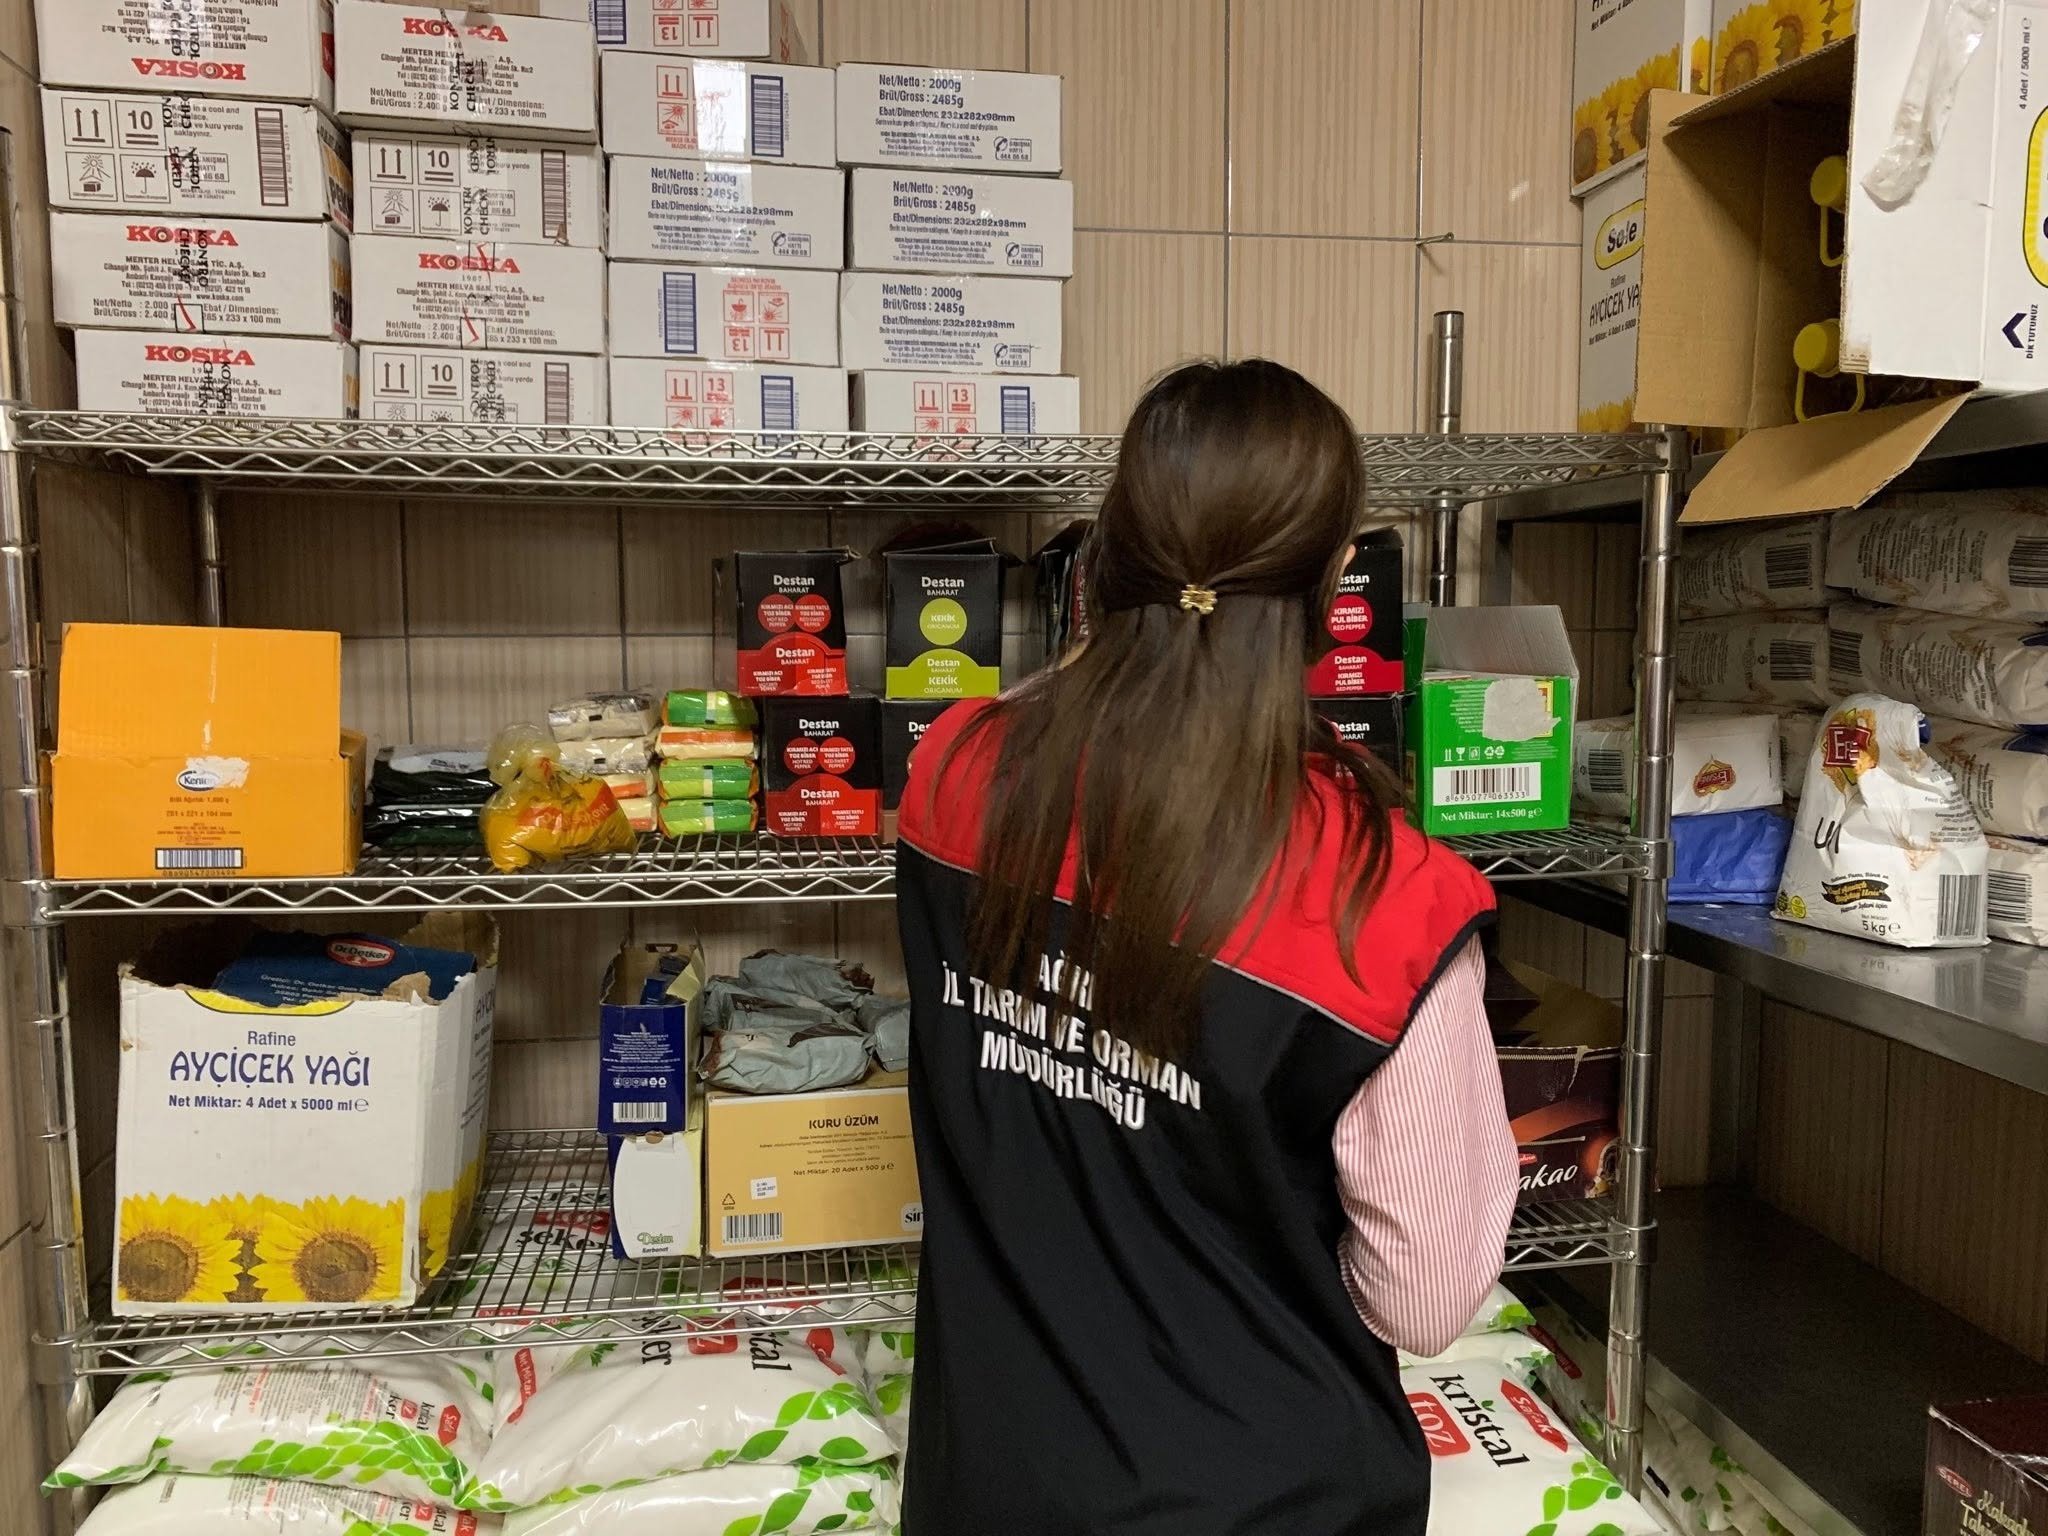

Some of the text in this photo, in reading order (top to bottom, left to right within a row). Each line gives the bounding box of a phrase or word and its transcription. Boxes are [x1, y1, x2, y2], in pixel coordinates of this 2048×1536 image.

[661, 27, 678, 40] 13
[2021, 29, 2031, 43] ml
[2020, 45, 2030, 70] 5000
[131, 58, 246, 80] KOSKA
[879, 75, 920, 88] Net/Netto
[370, 88, 407, 98] Net/Netto
[2019, 78, 2029, 100] Adet
[370, 97, 411, 108] Brüt/Gross
[498, 98, 545, 110] Dimensions:
[879, 90, 964, 108] Brüt/Gross 2485g
[495, 108, 508, 116] 233
[518, 109, 530, 117] 100
[2019, 102, 2027, 110] 4
[128, 110, 153, 129] 10
[428, 150, 449, 168] 10
[651, 168, 694, 180] Net/Netto
[652, 183, 698, 196] Brüt/Gross
[893, 181, 933, 194] Net/Netto
[893, 196, 976, 214] Brüt/Gross 2485g
[893, 213, 953, 225] Ebat/Dimensions:
[126, 225, 239, 246] KOSKA
[1607, 220, 1637, 254] Sole
[126, 256, 159, 264] MERTER
[418, 254, 520, 274] KOSKA
[882, 284, 963, 300] Net/Netto 2000g
[93, 299, 132, 308] Net/Netto
[228, 305, 279, 315] Dimensions:
[882, 298, 965, 316] Brüt/Gross 2485g
[94, 308, 137, 318] Brüt/Gross
[226, 314, 240, 322] 233
[882, 315, 1015, 329] Ebat/Dimensions: 232x282x98mm
[386, 330, 426, 339] Brüt/Gross
[510, 327, 556, 337] Dimensions:
[2026, 303, 2039, 359] DİK TUTUNUZ
[506, 336, 521, 344] 233
[732, 338, 748, 352] 13
[145, 346, 255, 366] KOSKA
[144, 374, 176, 382] MERTER
[431, 364, 451, 382] 10
[708, 378, 726, 392] 13
[952, 389, 969, 402] 13
[773, 575, 815, 586] Destan
[921, 577, 964, 588] Destan
[931, 613, 956, 622] KEKİK
[1334, 607, 1365, 615] KIRMIZI
[1346, 614, 1368, 623] BİBER
[776, 648, 815, 658] Destan
[928, 658, 960, 667] Destan
[1334, 656, 1367, 664] Destan
[928, 675, 958, 685] KEKİK
[799, 719, 840, 729] Destan
[801, 789, 840, 799] Destan
[1441, 812, 1457, 821] Net
[1460, 810, 1493, 819] Miktar:
[1496, 809, 1526, 818] 14x500
[1862, 921, 1886, 936] 5 kg
[247, 1030, 297, 1047] Rafine
[942, 960, 1201, 1110] İL TARIM VE ORMAN
[169, 1046, 370, 1088] AYÇİÇEK YAĞI
[980, 1030, 1146, 1130] MÜDÜRLÜĞÜ
[168, 1095, 353, 1112] Net Miktar: 4 Adet x 5000 ml
[809, 1115, 879, 1130] KURU ÜZÜM
